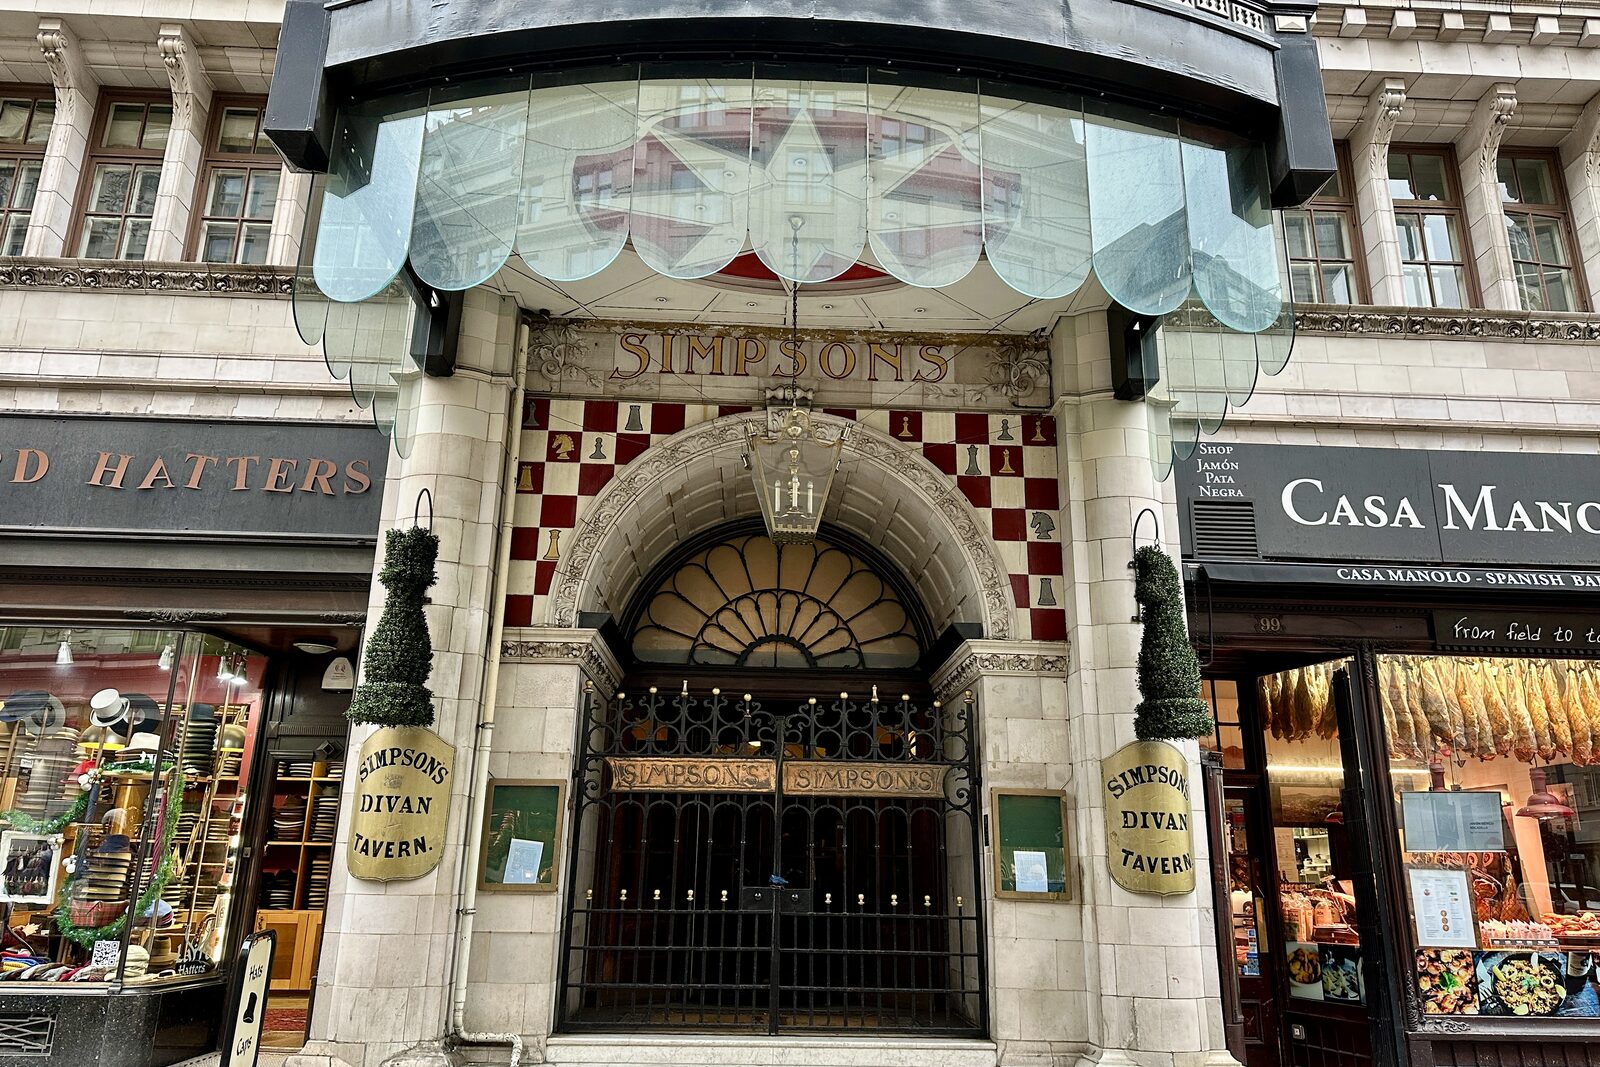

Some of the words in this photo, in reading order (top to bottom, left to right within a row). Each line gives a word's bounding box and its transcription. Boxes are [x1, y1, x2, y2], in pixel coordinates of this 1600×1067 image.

[609, 333, 948, 382] SIMPSONS
[0, 447, 51, 484] D
[85, 451, 372, 496] HATTERS
[1336, 568, 1385, 581] CASA
[1386, 569, 1471, 584] MANOLO
[1486, 572, 1565, 586] SPANISH
[1260, 617, 1281, 631] 99
[1506, 622, 1542, 642] field
[1553, 626, 1573, 642] to
[796, 767, 932, 792] SIMPSON'S
[359, 794, 433, 815] DIVAN
[1121, 810, 1188, 831] DIVAN
[353, 832, 433, 859] TAVERN.
[248, 964, 264, 982] Hats
[236, 1036, 253, 1057] Caps
